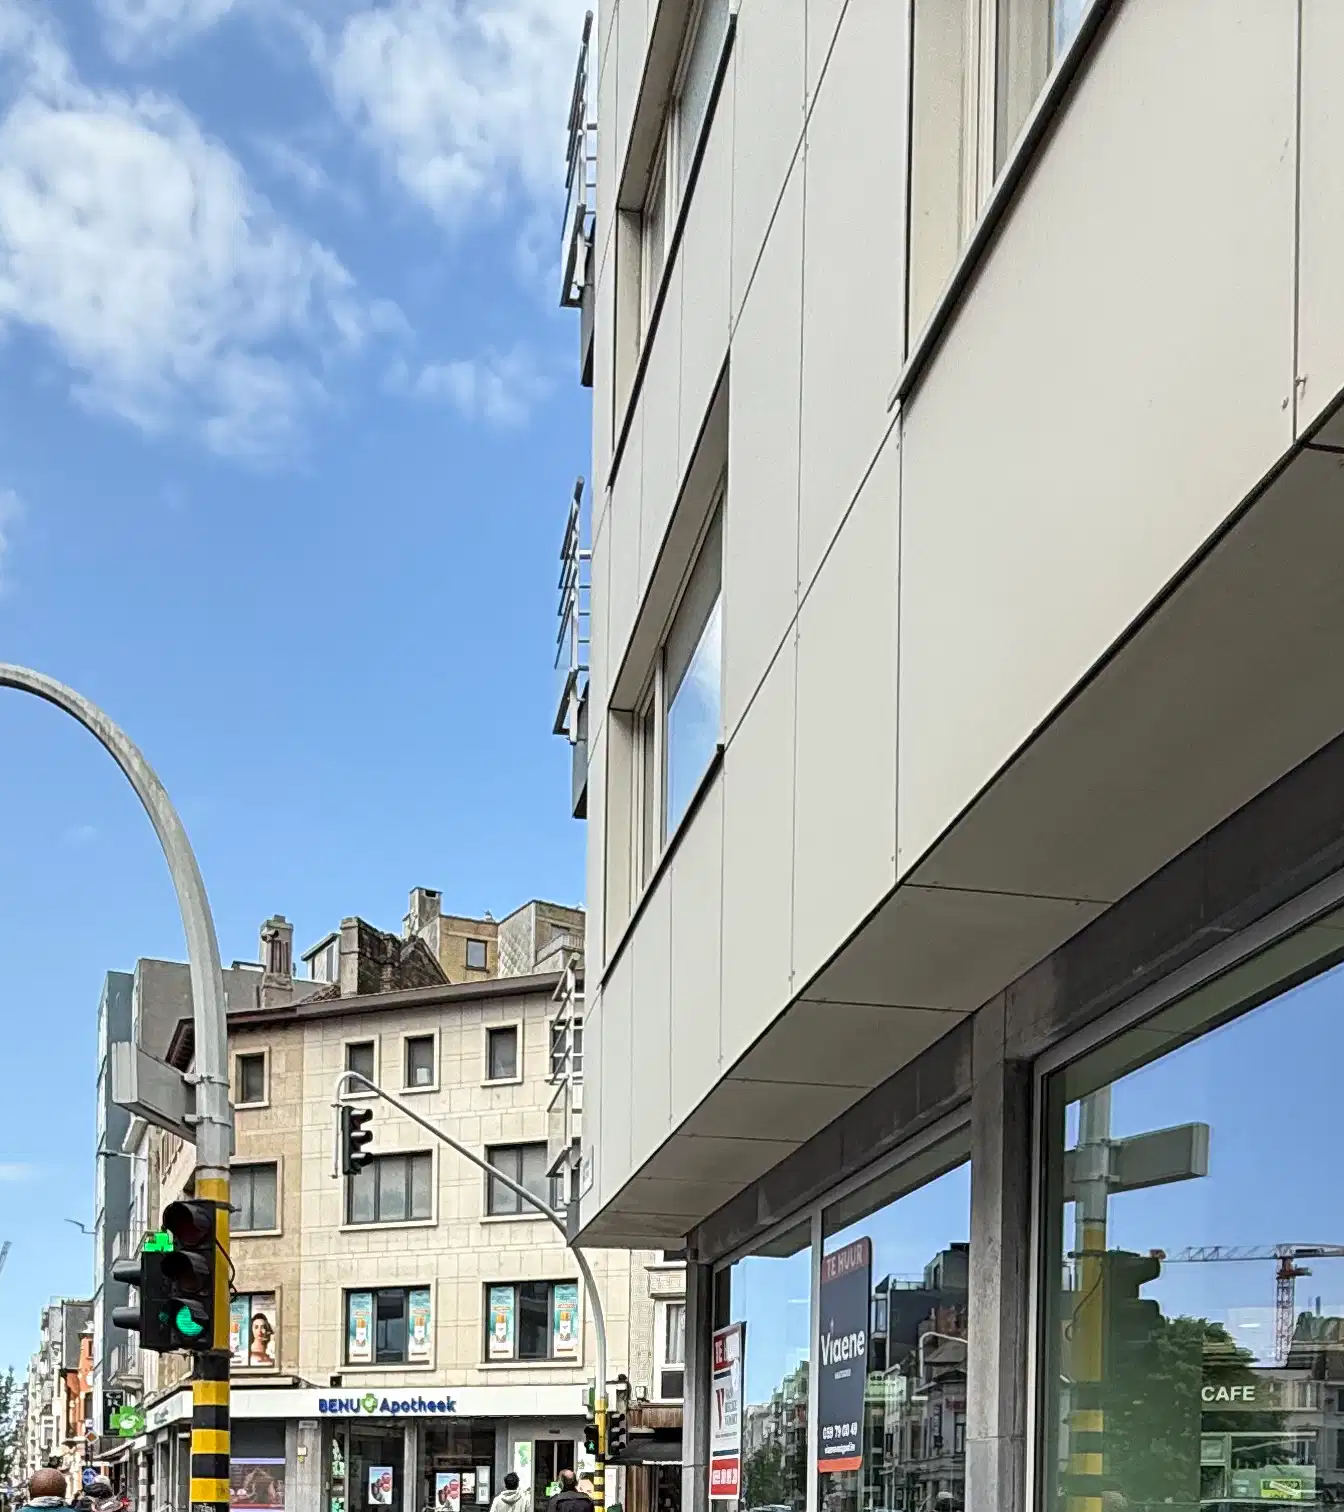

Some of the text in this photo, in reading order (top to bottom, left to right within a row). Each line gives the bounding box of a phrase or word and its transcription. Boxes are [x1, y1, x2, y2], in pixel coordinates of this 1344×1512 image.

[820, 1329, 865, 1366] Viaene
[1201, 1385, 1256, 1402] CAFE
[318, 1396, 457, 1417] BENU Apotheek
